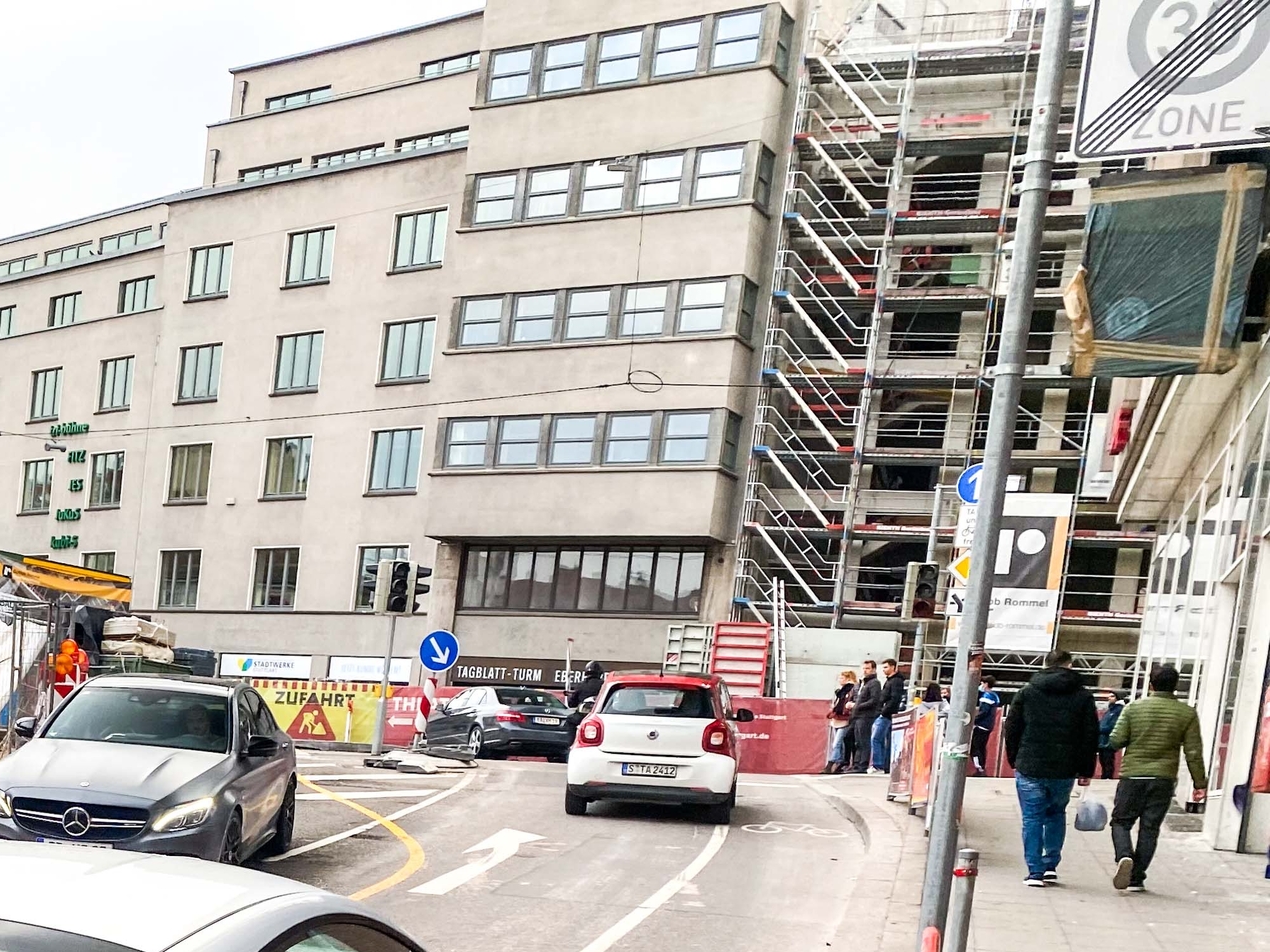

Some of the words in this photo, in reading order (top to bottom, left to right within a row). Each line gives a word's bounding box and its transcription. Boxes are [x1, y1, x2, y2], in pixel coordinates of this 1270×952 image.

[1132, 100, 1245, 140] ZONE
[1004, 597, 1049, 608] Rommel
[253, 661, 295, 669] STADTWERKE
[456, 665, 542, 682] TAGBLATT-TURM
[274, 691, 356, 708] ZUFAHRT
[653, 765, 676, 775] 2412
